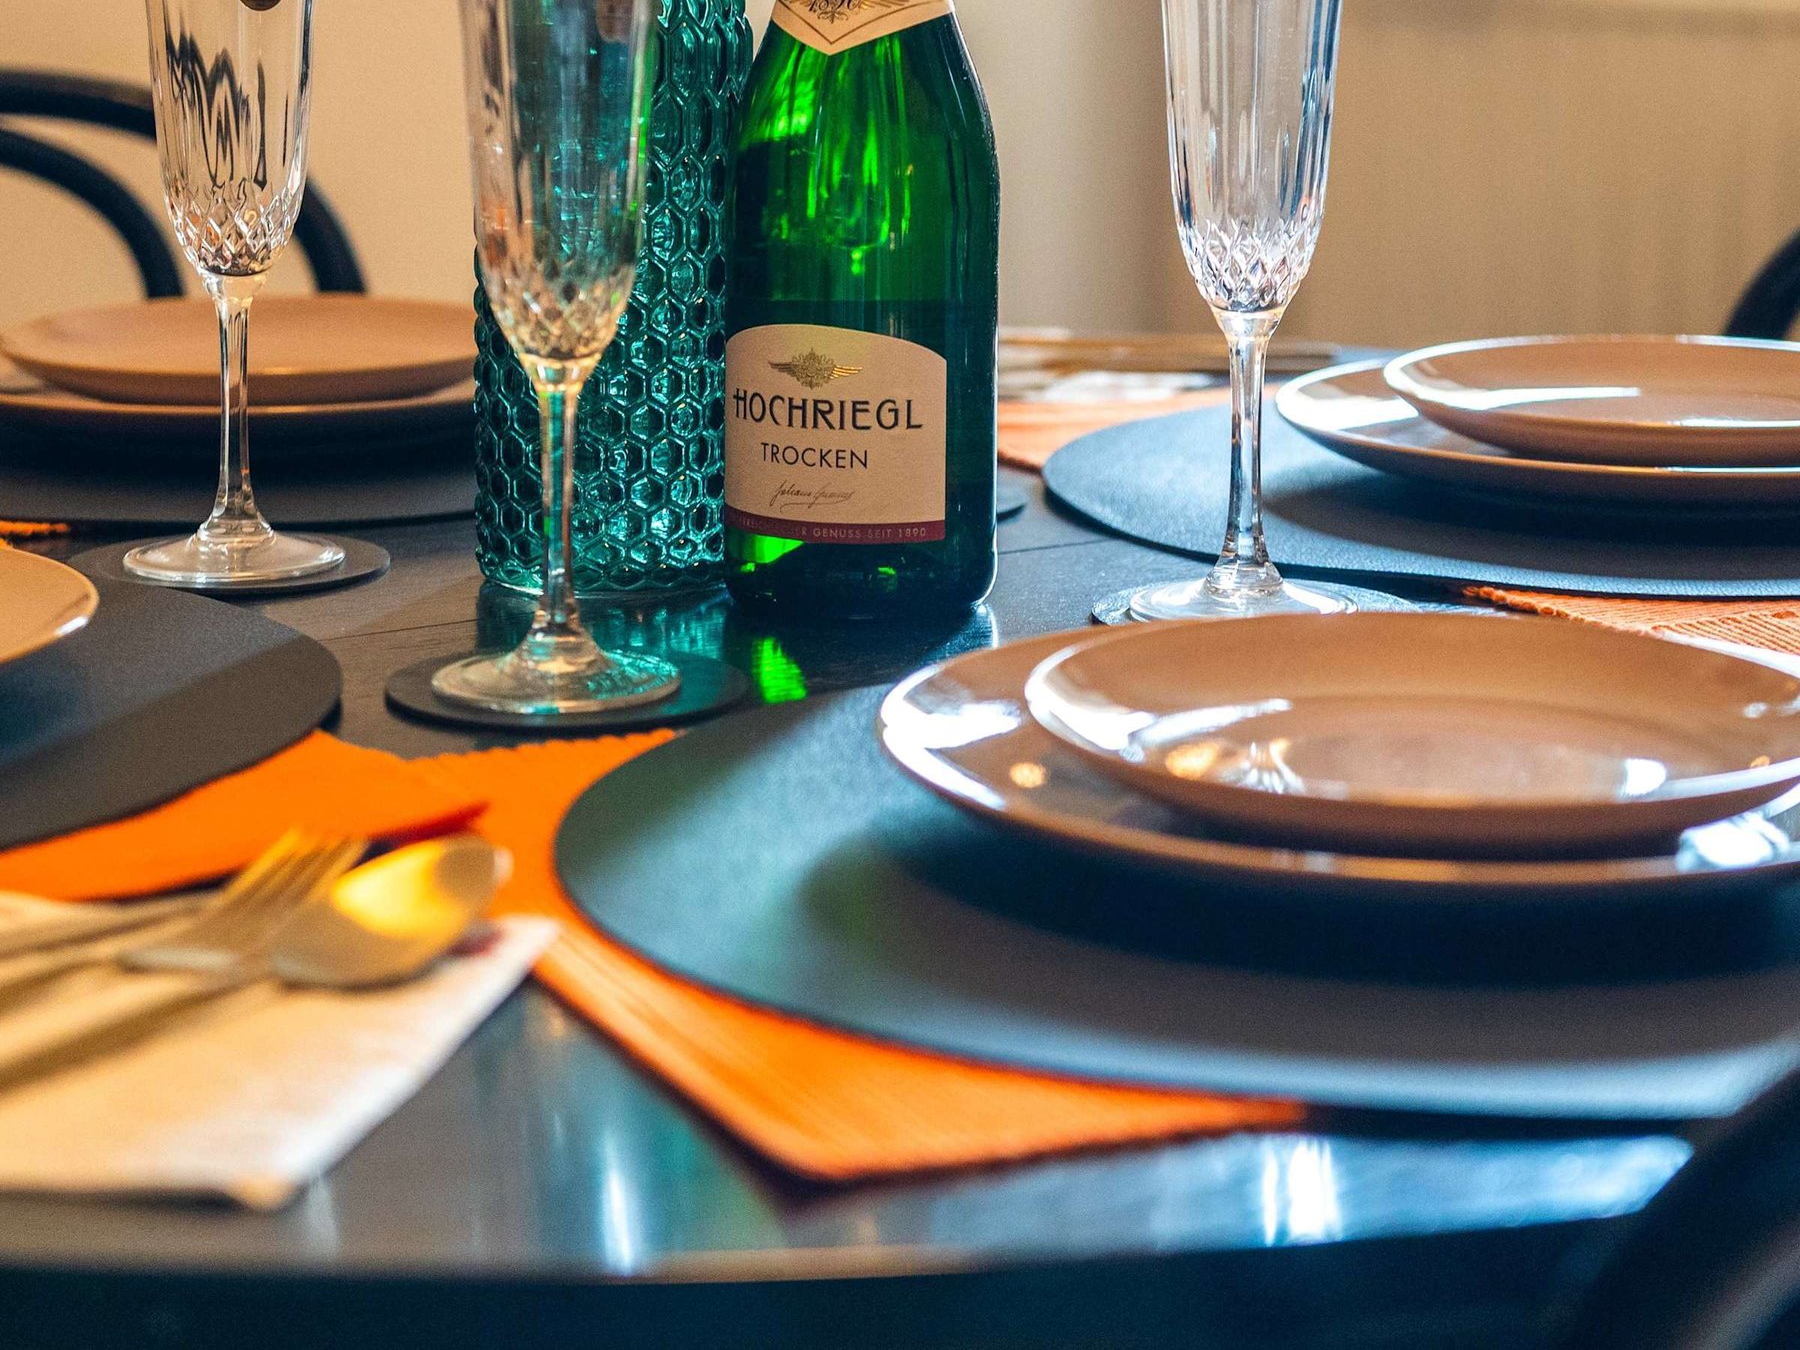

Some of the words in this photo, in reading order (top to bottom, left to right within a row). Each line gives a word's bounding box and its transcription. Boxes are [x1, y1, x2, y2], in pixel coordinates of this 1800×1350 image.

[733, 388, 923, 430] HOCHRIEGL
[761, 442, 868, 469] TROCKEN
[812, 527, 861, 539] GENUSS
[867, 528, 892, 539] SEIT
[898, 527, 927, 538] 1890
